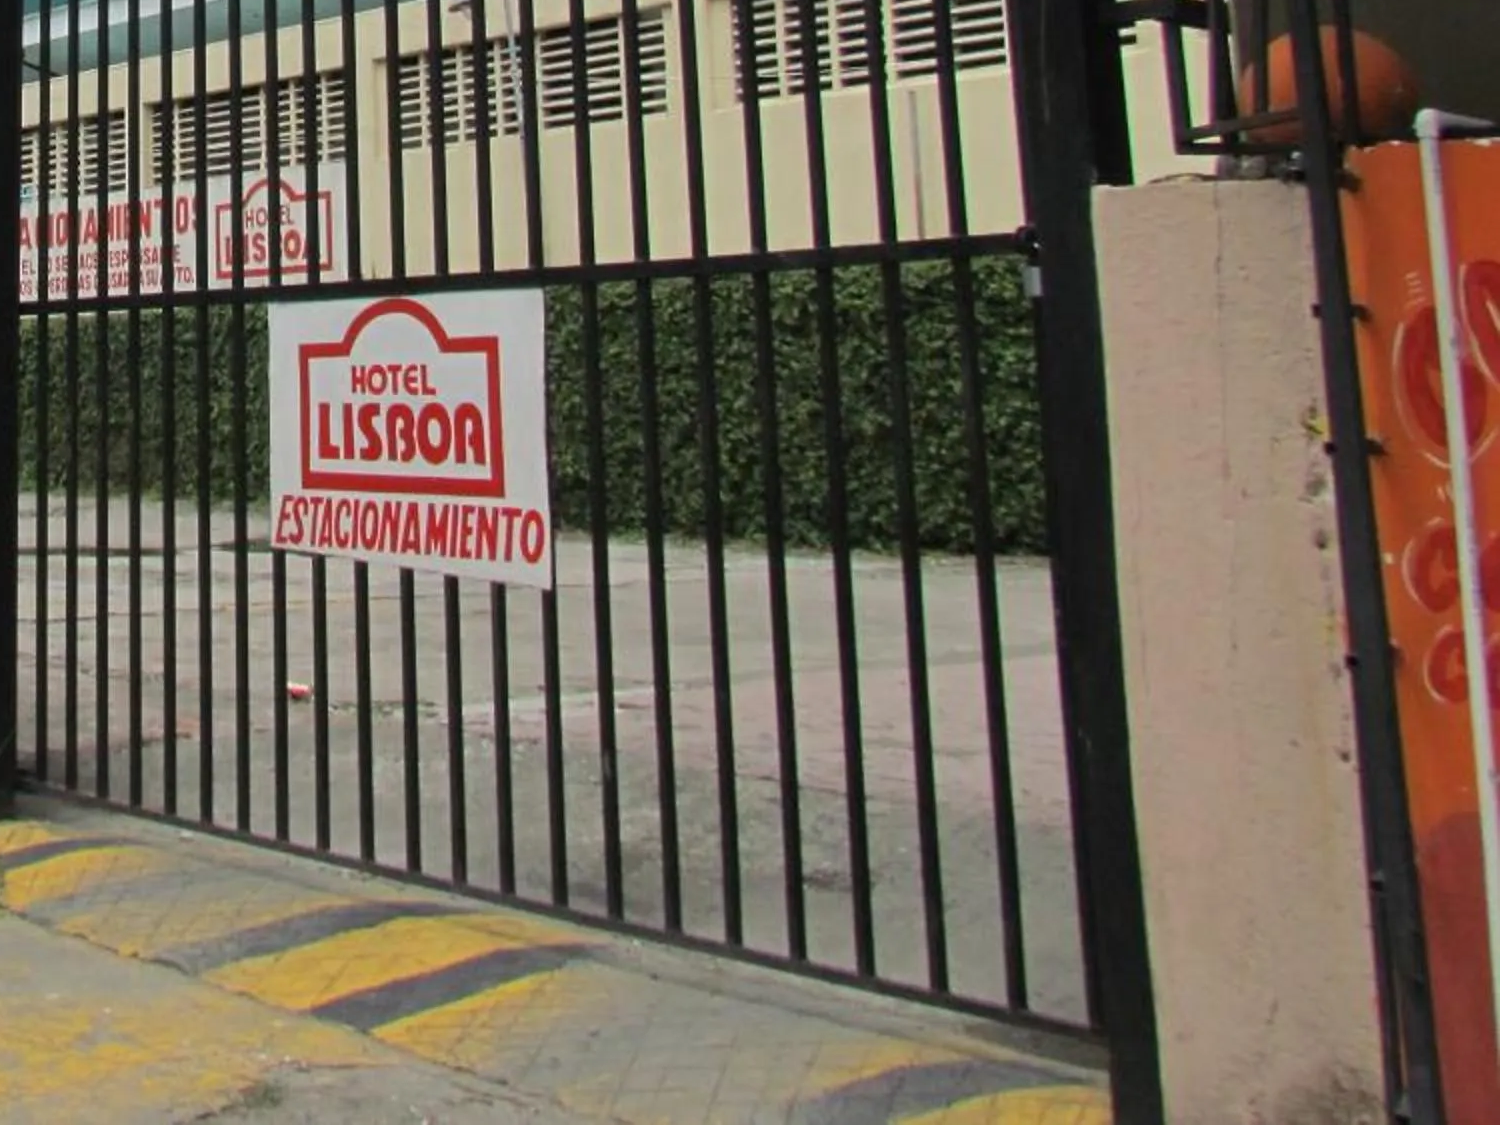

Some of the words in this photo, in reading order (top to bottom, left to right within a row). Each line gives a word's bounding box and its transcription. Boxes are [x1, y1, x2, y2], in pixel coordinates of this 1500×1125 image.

[245, 205, 294, 228] HOEL
[350, 364, 436, 396] HOTEL
[317, 402, 486, 466] LISBOA
[274, 494, 545, 566] ESTACIONAMIENTO
